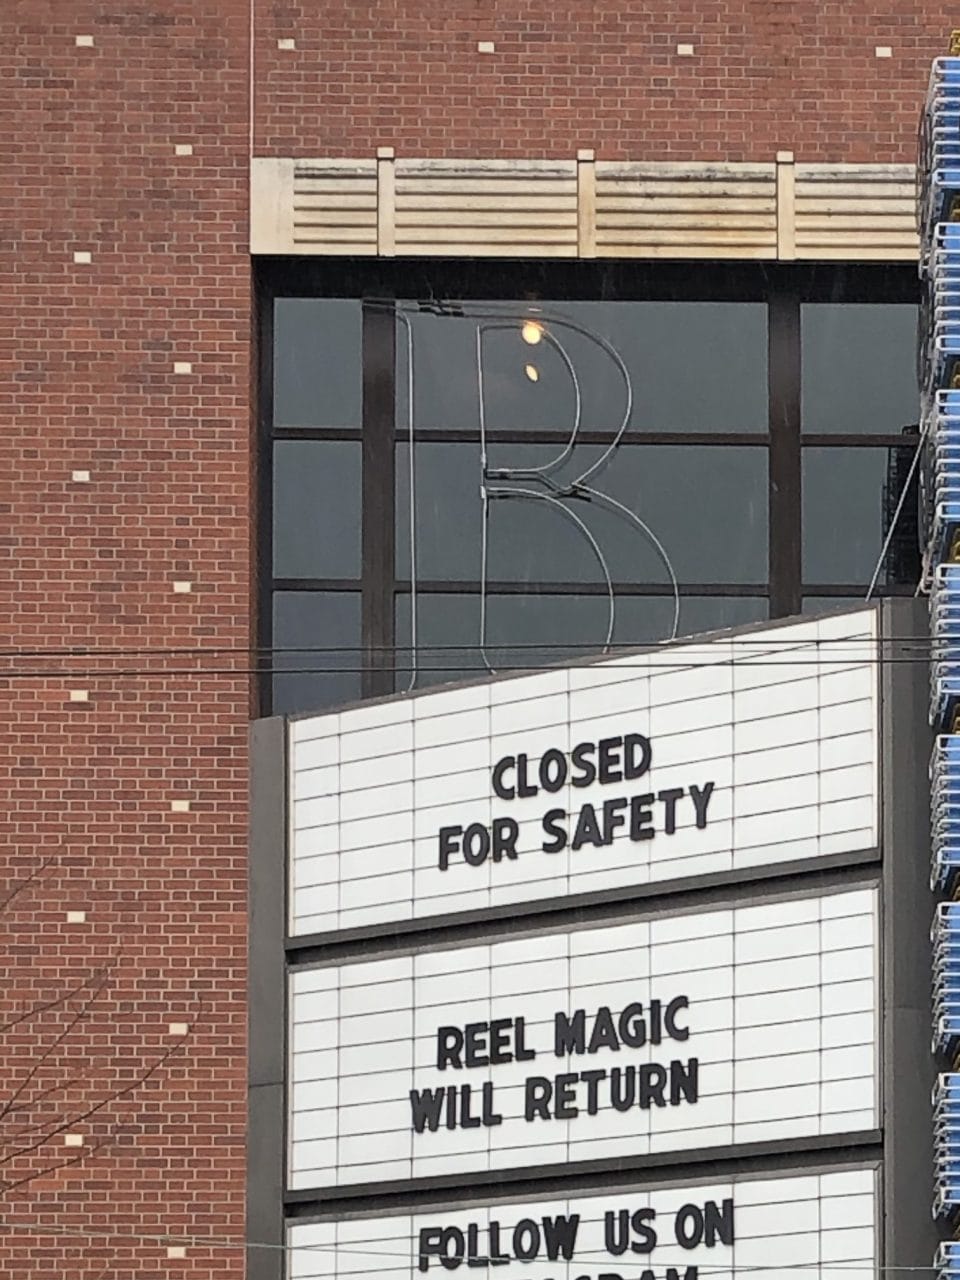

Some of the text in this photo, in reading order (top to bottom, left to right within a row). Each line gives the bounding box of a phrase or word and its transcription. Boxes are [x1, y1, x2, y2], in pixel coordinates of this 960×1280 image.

[491, 733, 653, 800] CLOSED
[438, 782, 714, 871] FOR SAFETY
[437, 995, 690, 1071] REEL MAGIC
[409, 1058, 699, 1134] WILL RETURN
[418, 1198, 735, 1273] FOLLOW US ON
